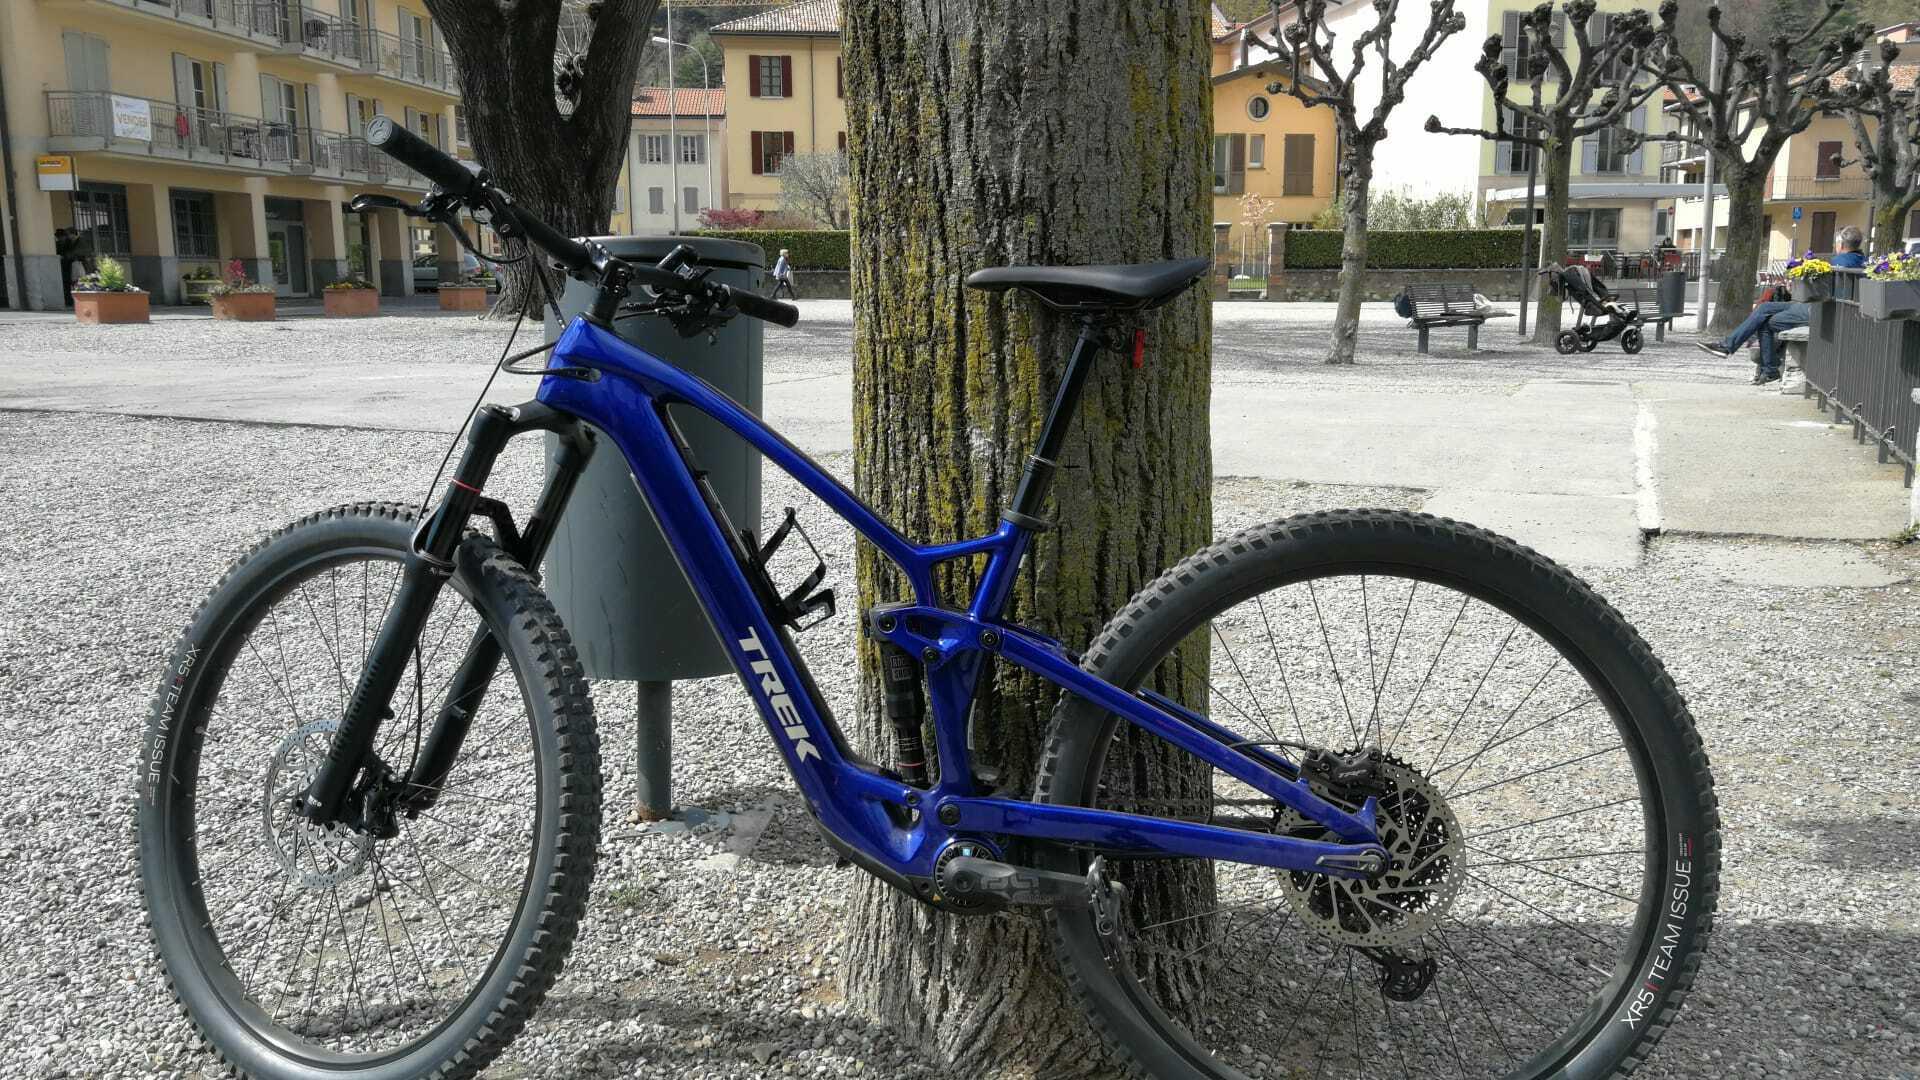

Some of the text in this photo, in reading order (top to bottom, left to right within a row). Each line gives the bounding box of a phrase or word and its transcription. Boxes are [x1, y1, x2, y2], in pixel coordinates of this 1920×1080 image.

[177, 643, 201, 678] XR5
[158, 684, 184, 731] TEAM
[738, 625, 822, 764] TREK
[148, 734, 167, 784] ISSUE
[1620, 988, 1655, 1030] XR5
[1648, 922, 1682, 980] TEAM
[1669, 859, 1692, 920] ISSUE
